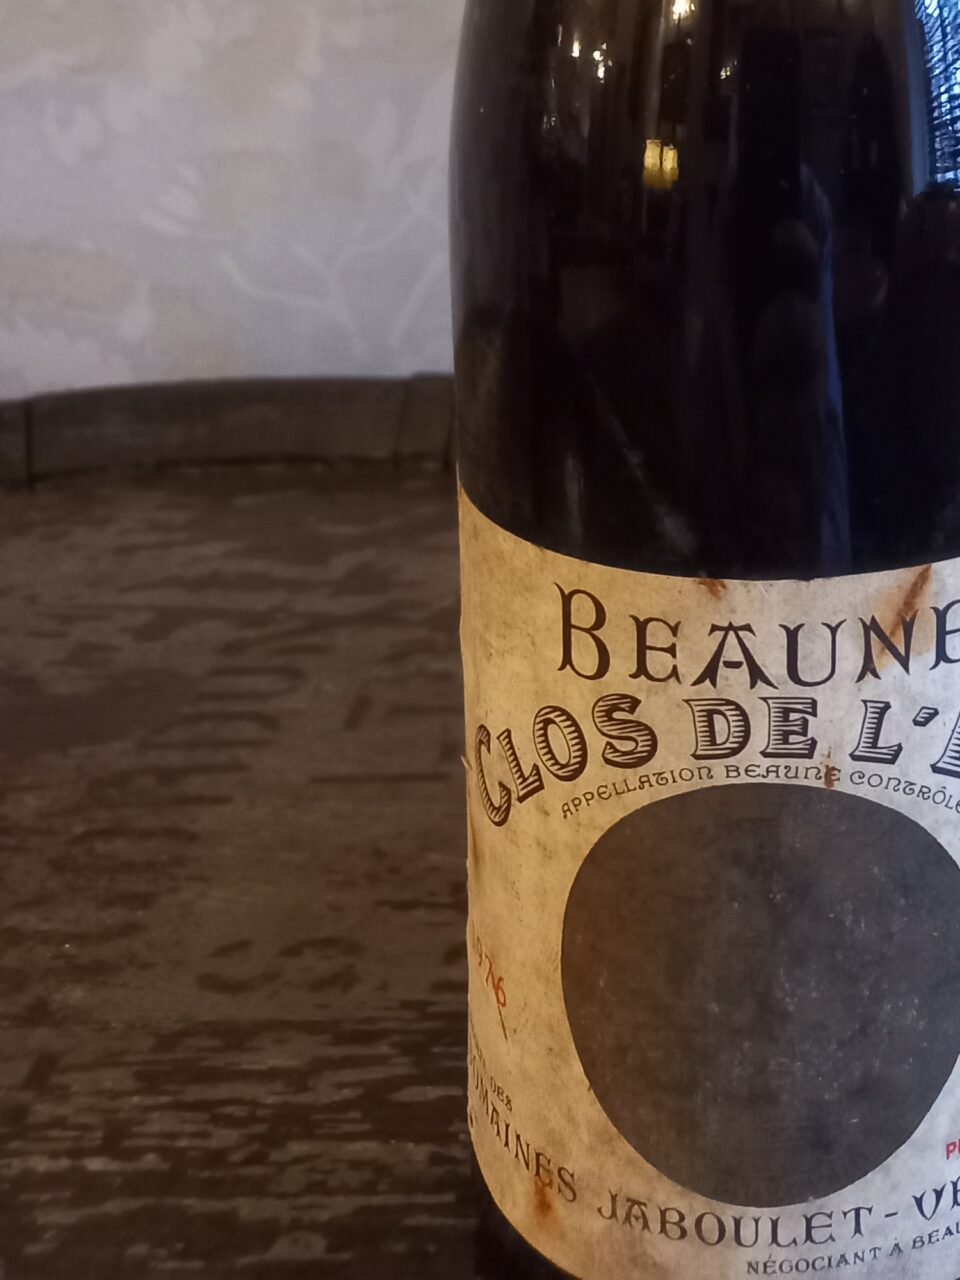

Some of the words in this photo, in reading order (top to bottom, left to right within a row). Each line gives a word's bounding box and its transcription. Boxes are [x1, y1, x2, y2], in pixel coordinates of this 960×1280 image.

[475, 693, 658, 827] CLOS
[683, 696, 818, 761] DE
[561, 766, 713, 819] APPELLATION
[724, 763, 842, 783] BEAUNE
[746, 1246, 882, 1276] NÉGOCIANT
[889, 1237, 904, 1257] À
